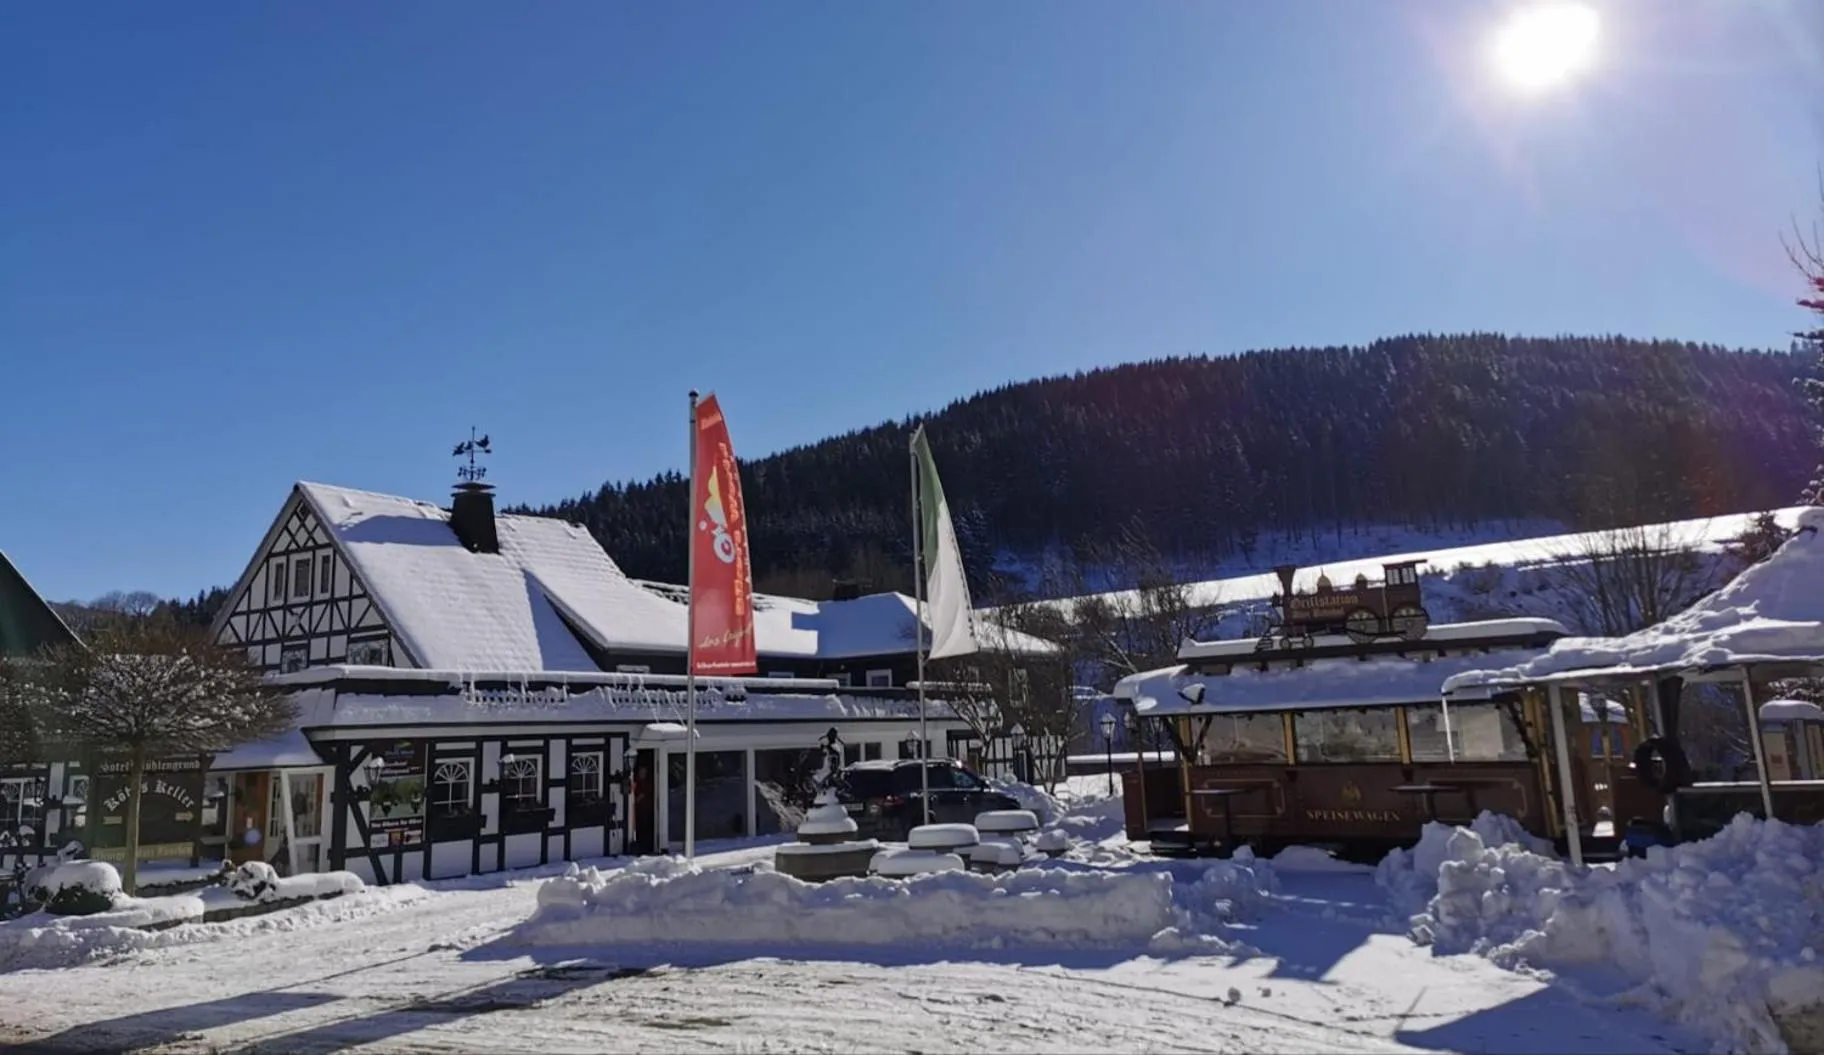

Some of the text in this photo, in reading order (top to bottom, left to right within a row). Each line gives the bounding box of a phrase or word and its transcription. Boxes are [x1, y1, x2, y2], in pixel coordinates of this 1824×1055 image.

[100, 759, 130, 772] Hotel
[155, 780, 194, 808] Keller
[1306, 810, 1401, 821] SPEISEWAGEN
